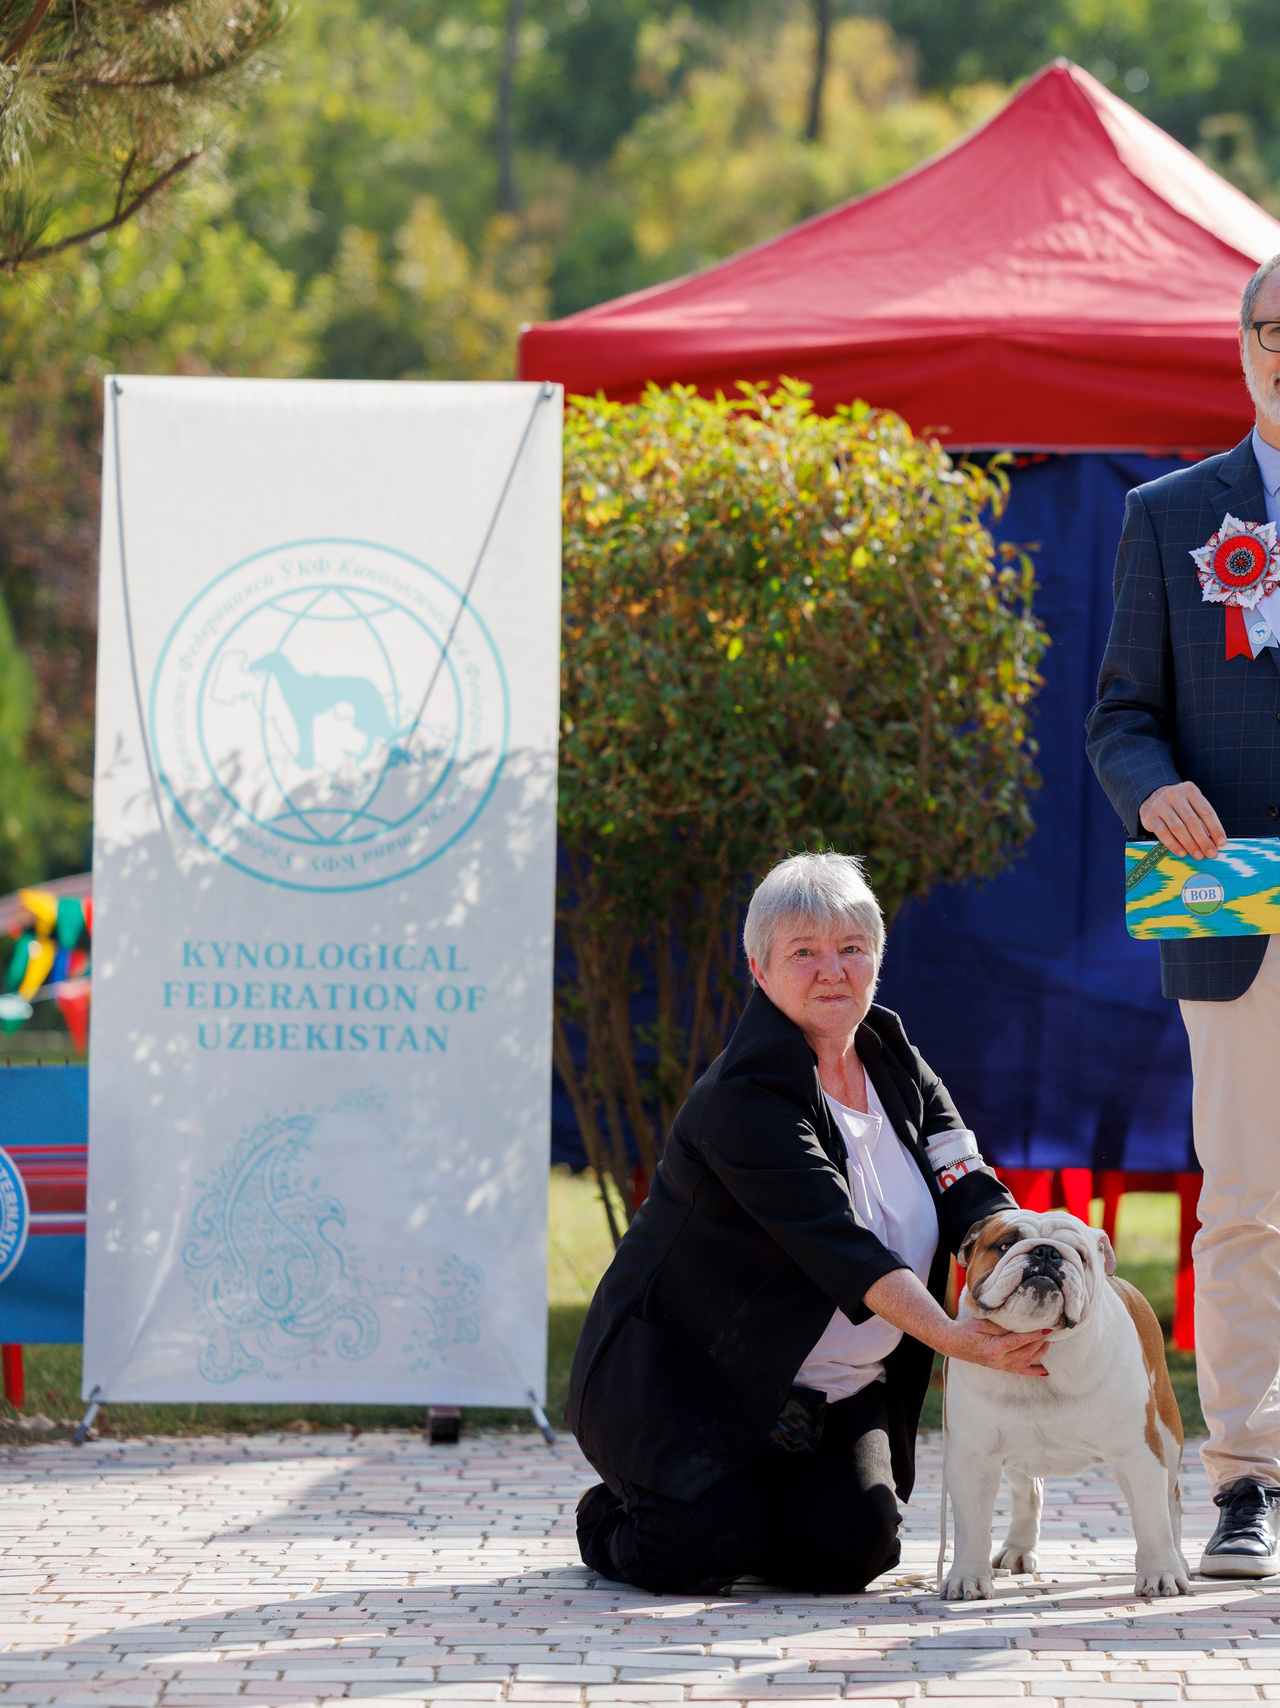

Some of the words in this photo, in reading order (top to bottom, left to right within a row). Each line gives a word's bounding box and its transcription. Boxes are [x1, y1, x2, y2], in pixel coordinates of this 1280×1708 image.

[1190, 888, 1217, 901] BOB
[181, 940, 470, 973] KYNOLOGICAL
[161, 981, 418, 1012] FEDERATION
[435, 985, 487, 1013] OF
[196, 1022, 450, 1053] UZBEKISTAN
